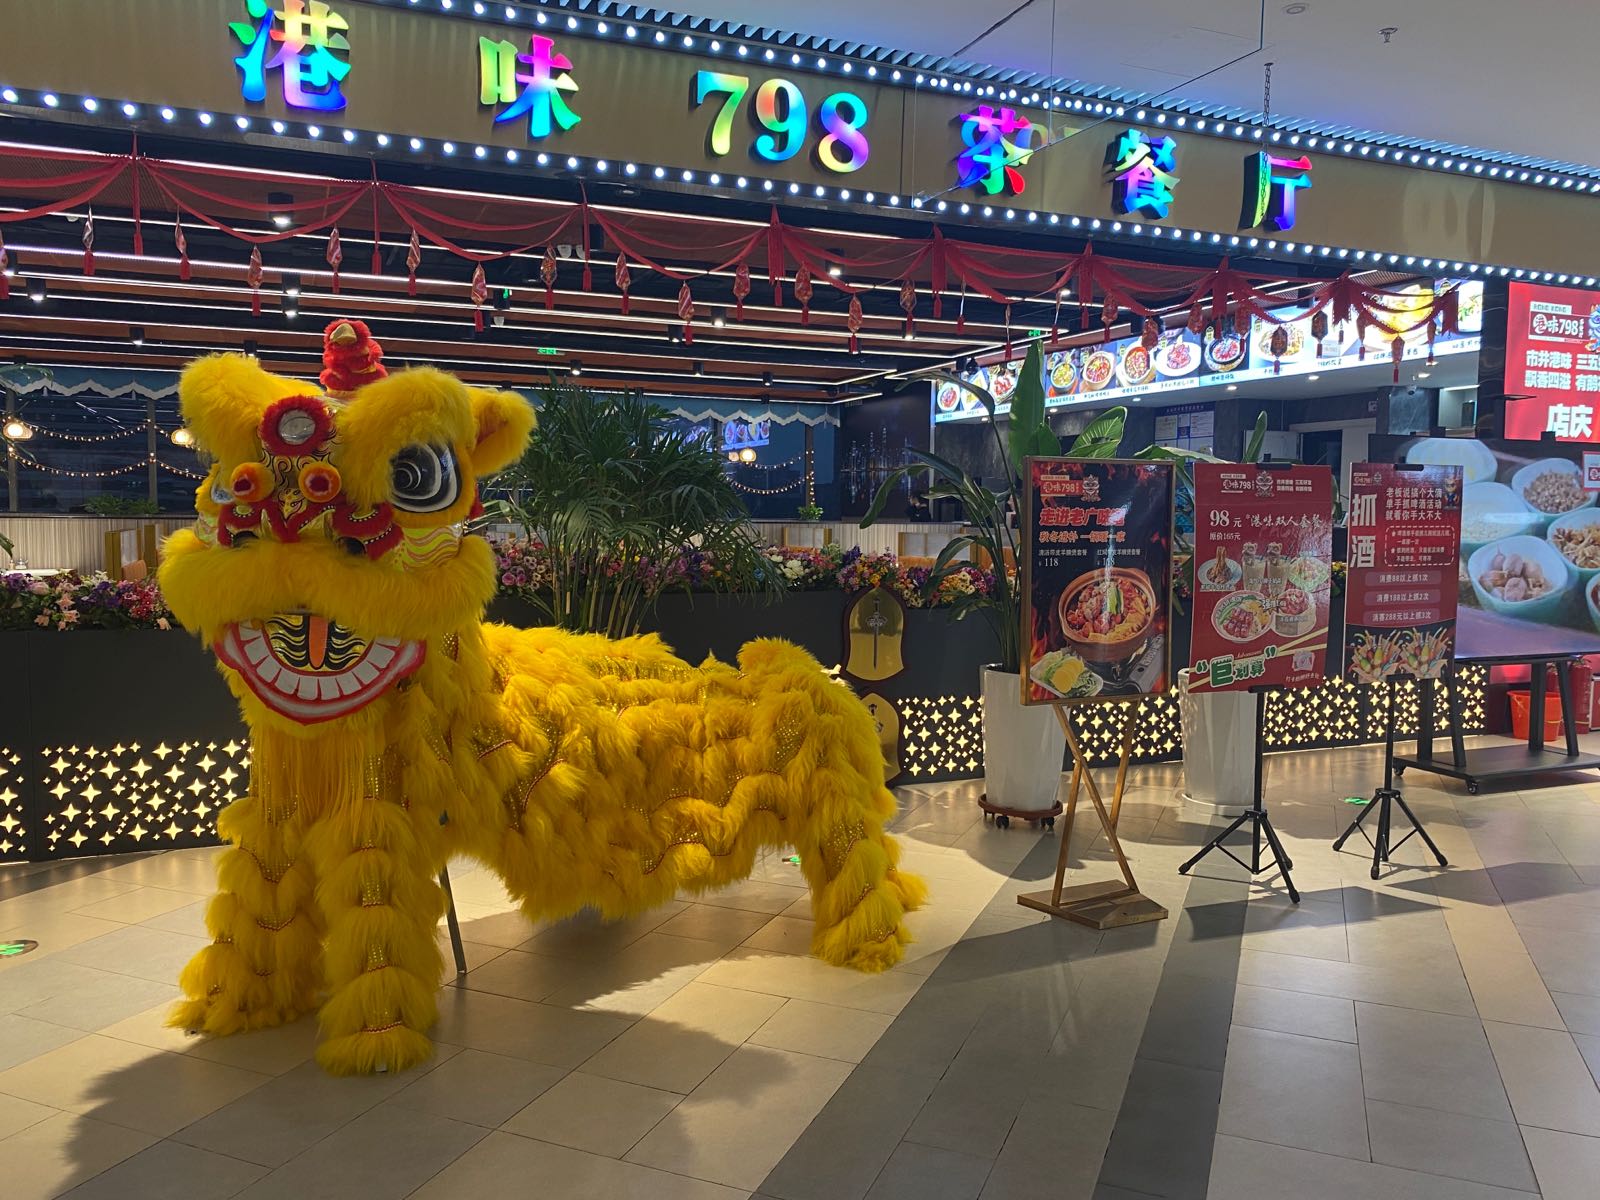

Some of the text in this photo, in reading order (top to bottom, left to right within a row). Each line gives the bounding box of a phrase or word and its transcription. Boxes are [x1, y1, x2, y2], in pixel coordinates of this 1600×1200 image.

[1526, 350, 1600, 371] 市井港味 三五
[1546, 403, 1593, 438] 店庆
[1386, 499, 1442, 509] 单手抓啤酒活动
[1385, 510, 1442, 521] 就看你手大不大
